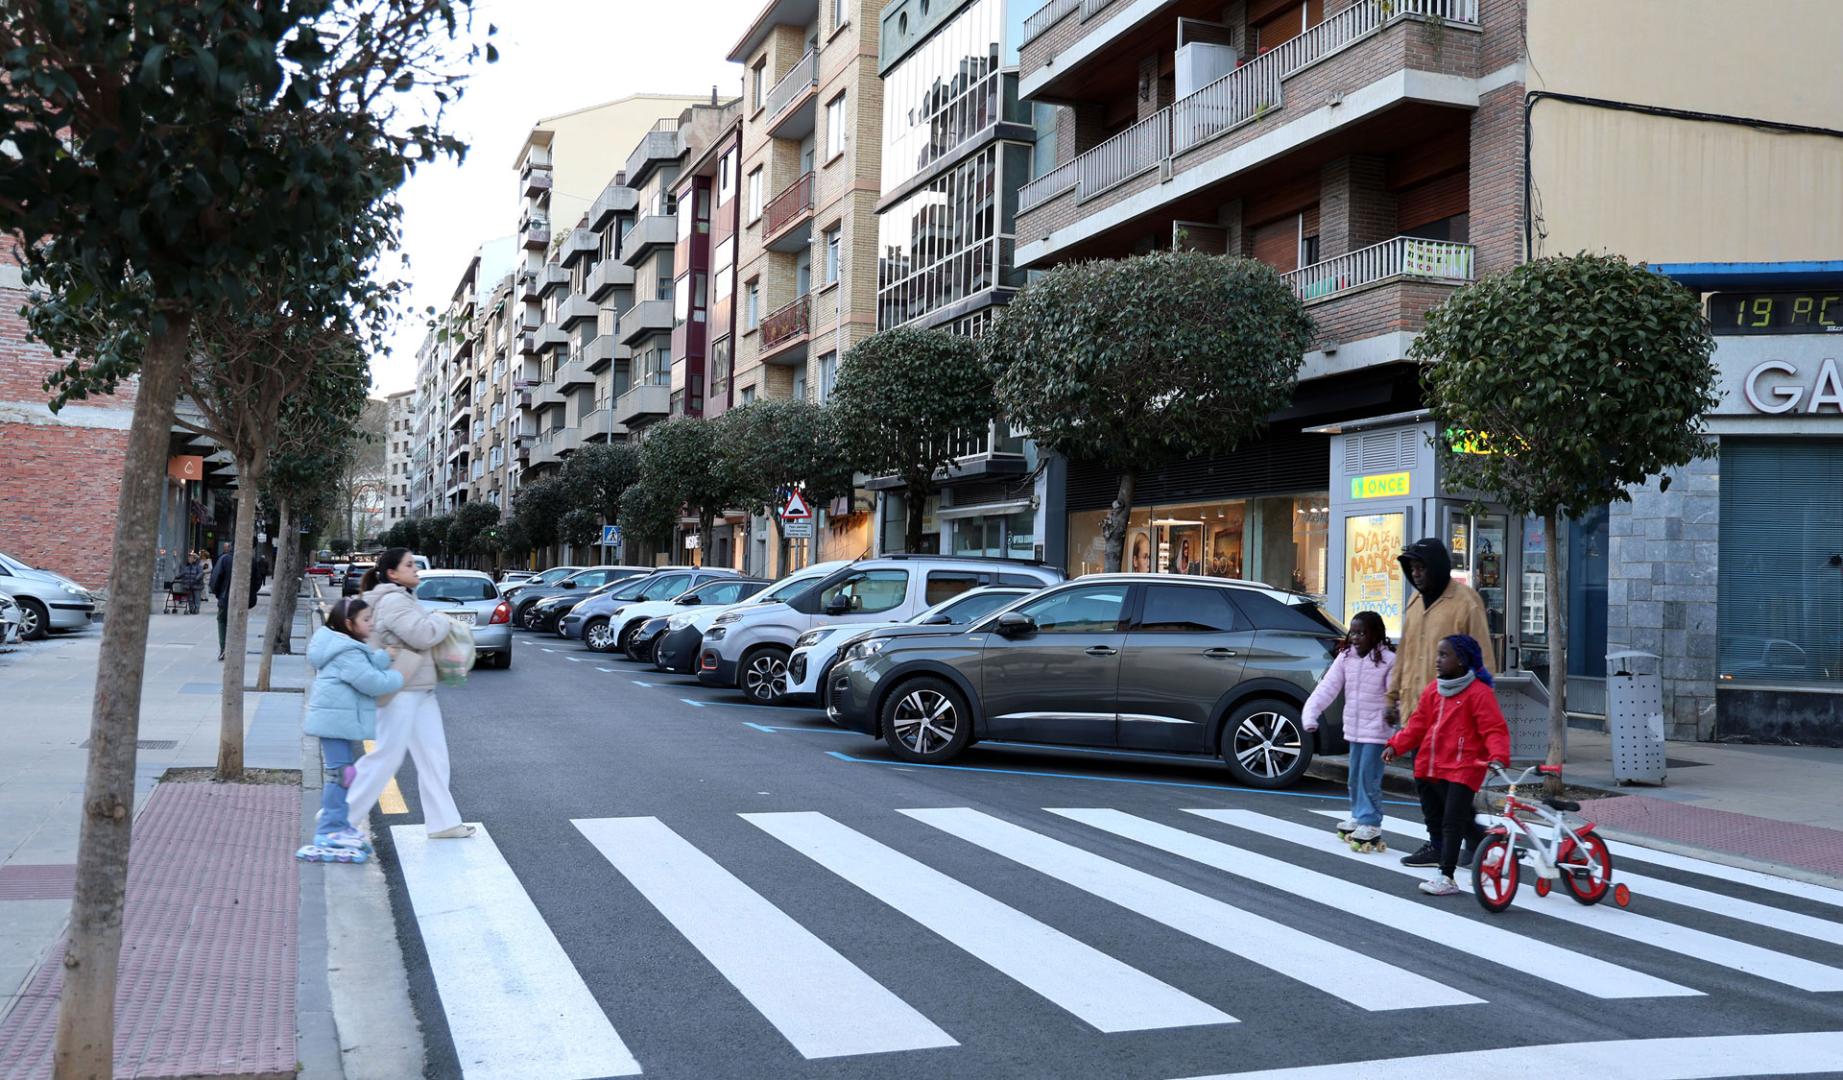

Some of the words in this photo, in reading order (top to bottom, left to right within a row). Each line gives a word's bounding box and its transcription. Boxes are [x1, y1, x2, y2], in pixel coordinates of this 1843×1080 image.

[1737, 298, 1773, 327] 19
[1744, 358, 1843, 414] GA
[1368, 477, 1405, 495] ONCE
[1354, 529, 1379, 553] DÍA
[1351, 545, 1399, 583] MADRE
